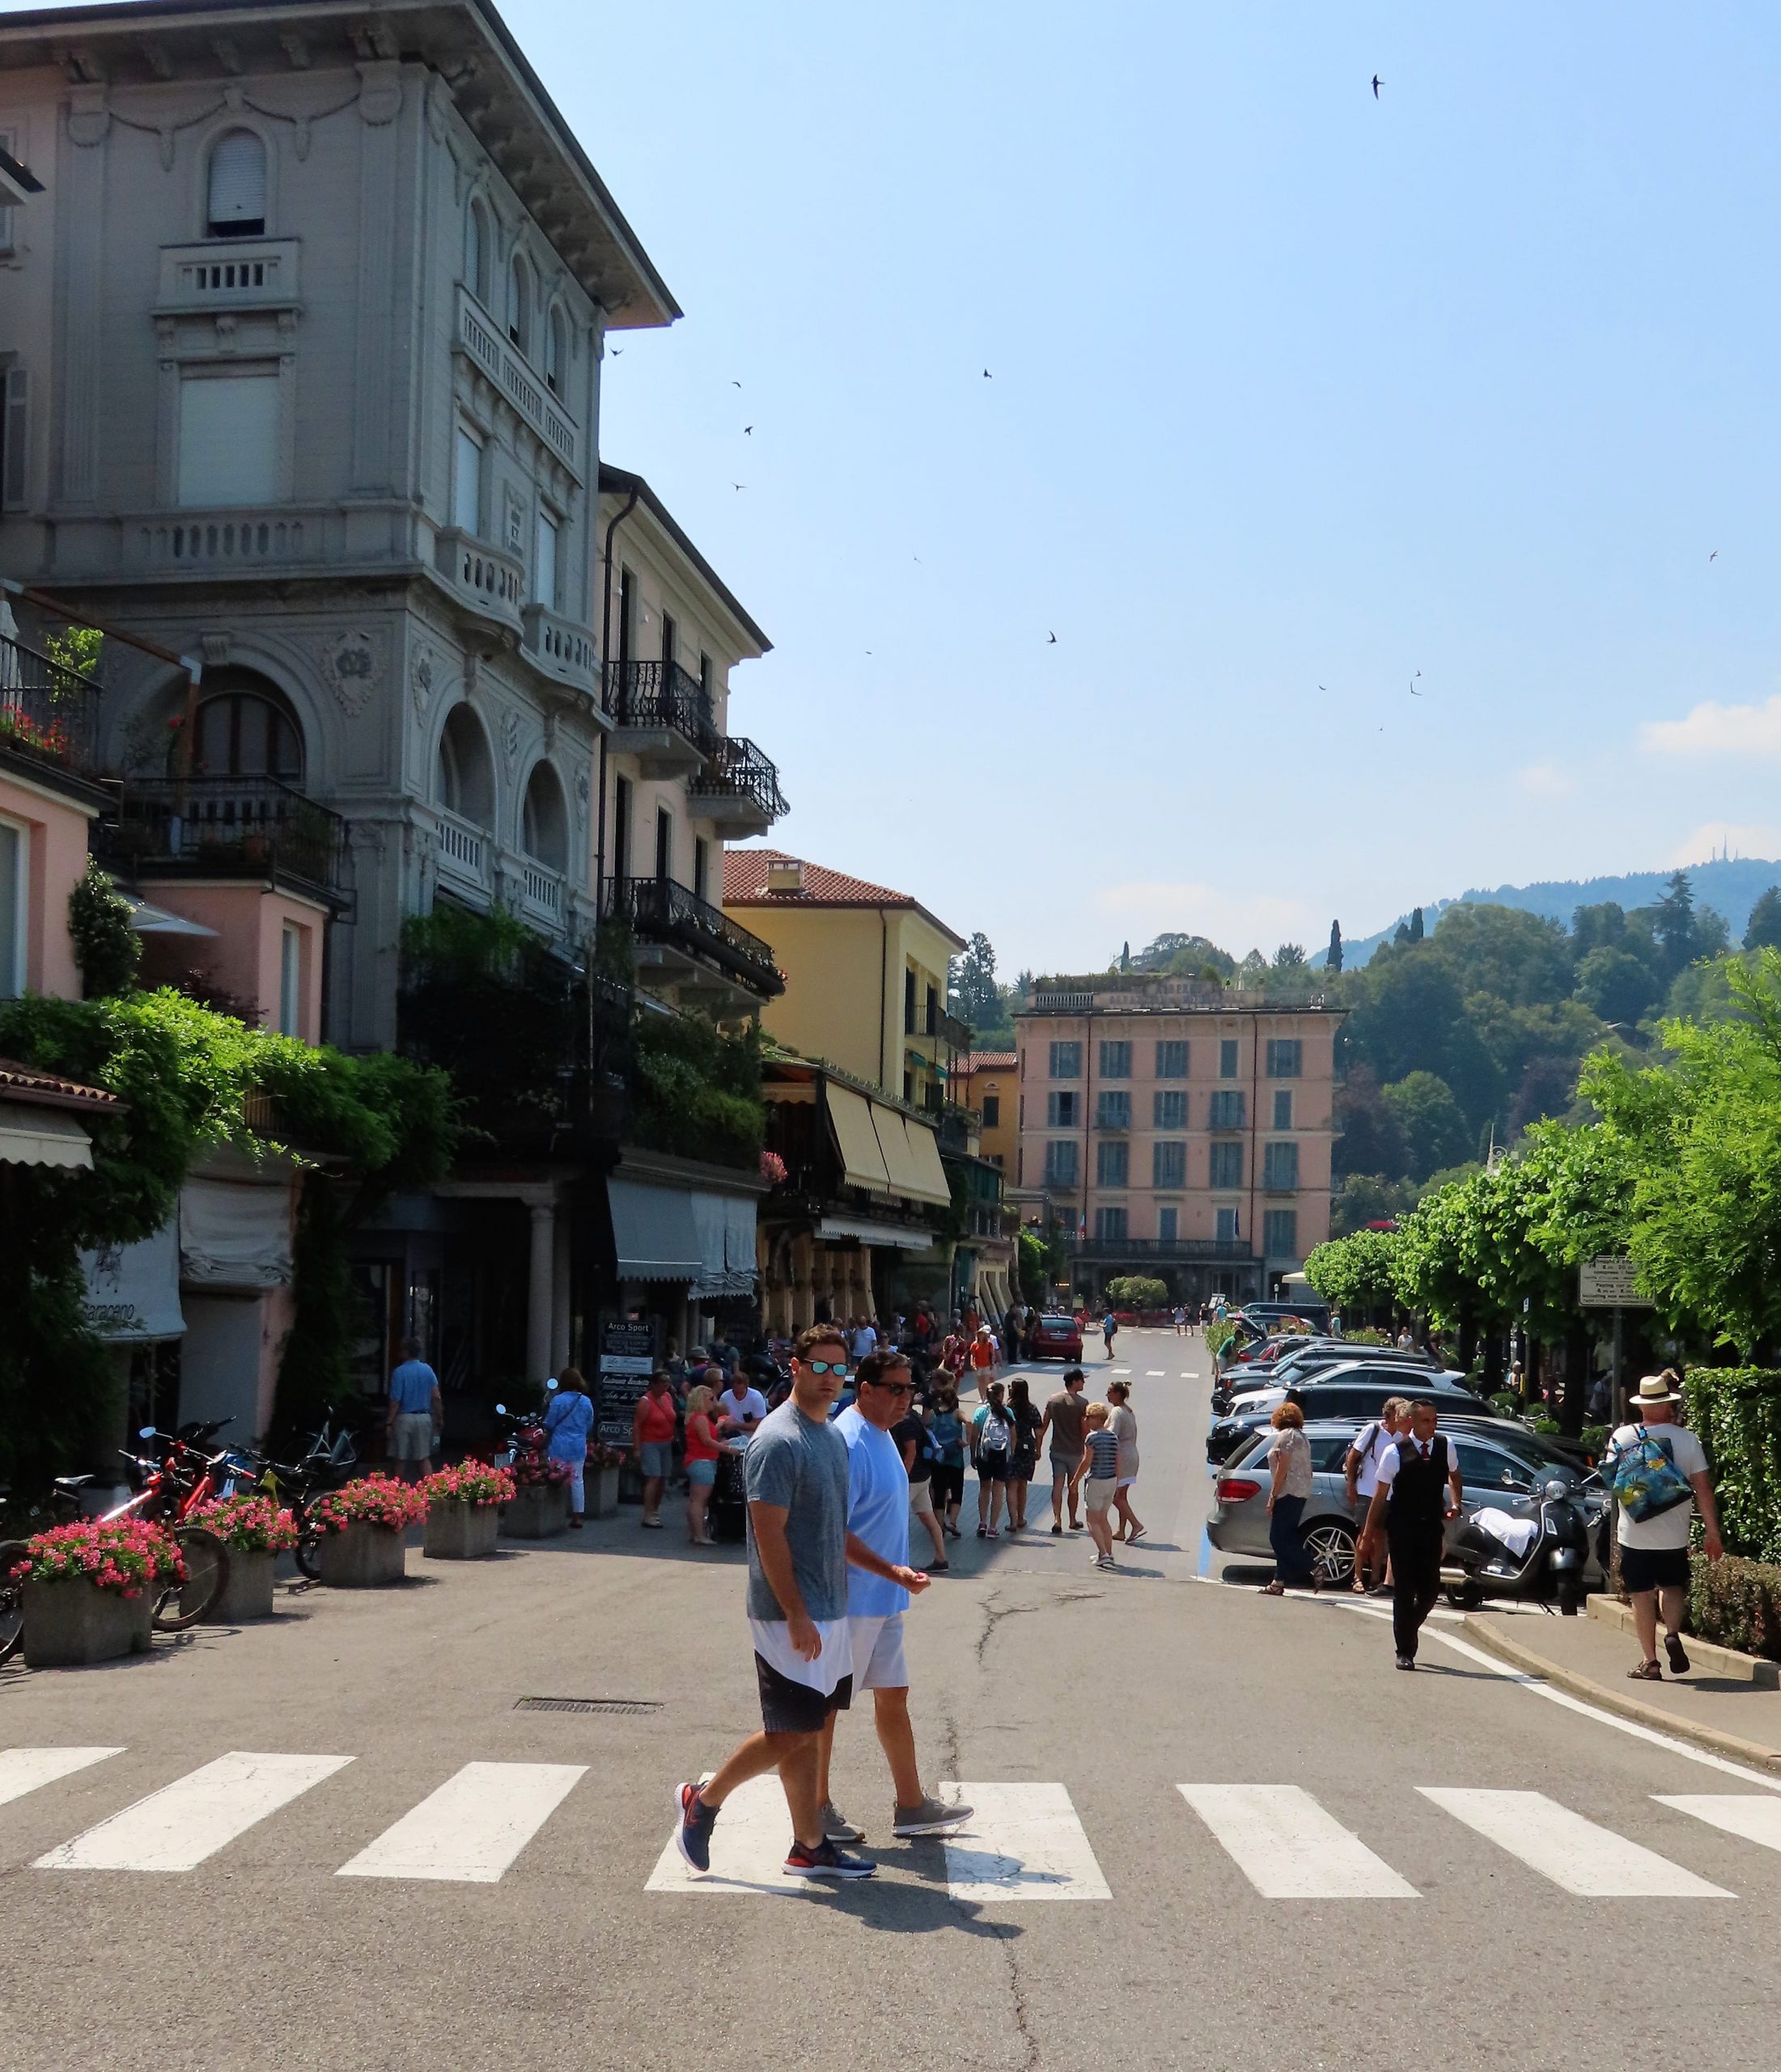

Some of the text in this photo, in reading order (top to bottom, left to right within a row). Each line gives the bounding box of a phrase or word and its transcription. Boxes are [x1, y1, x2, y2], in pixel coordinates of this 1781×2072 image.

[608, 1323, 649, 1332] Arco Sport
[600, 1424, 621, 1433] Arco
